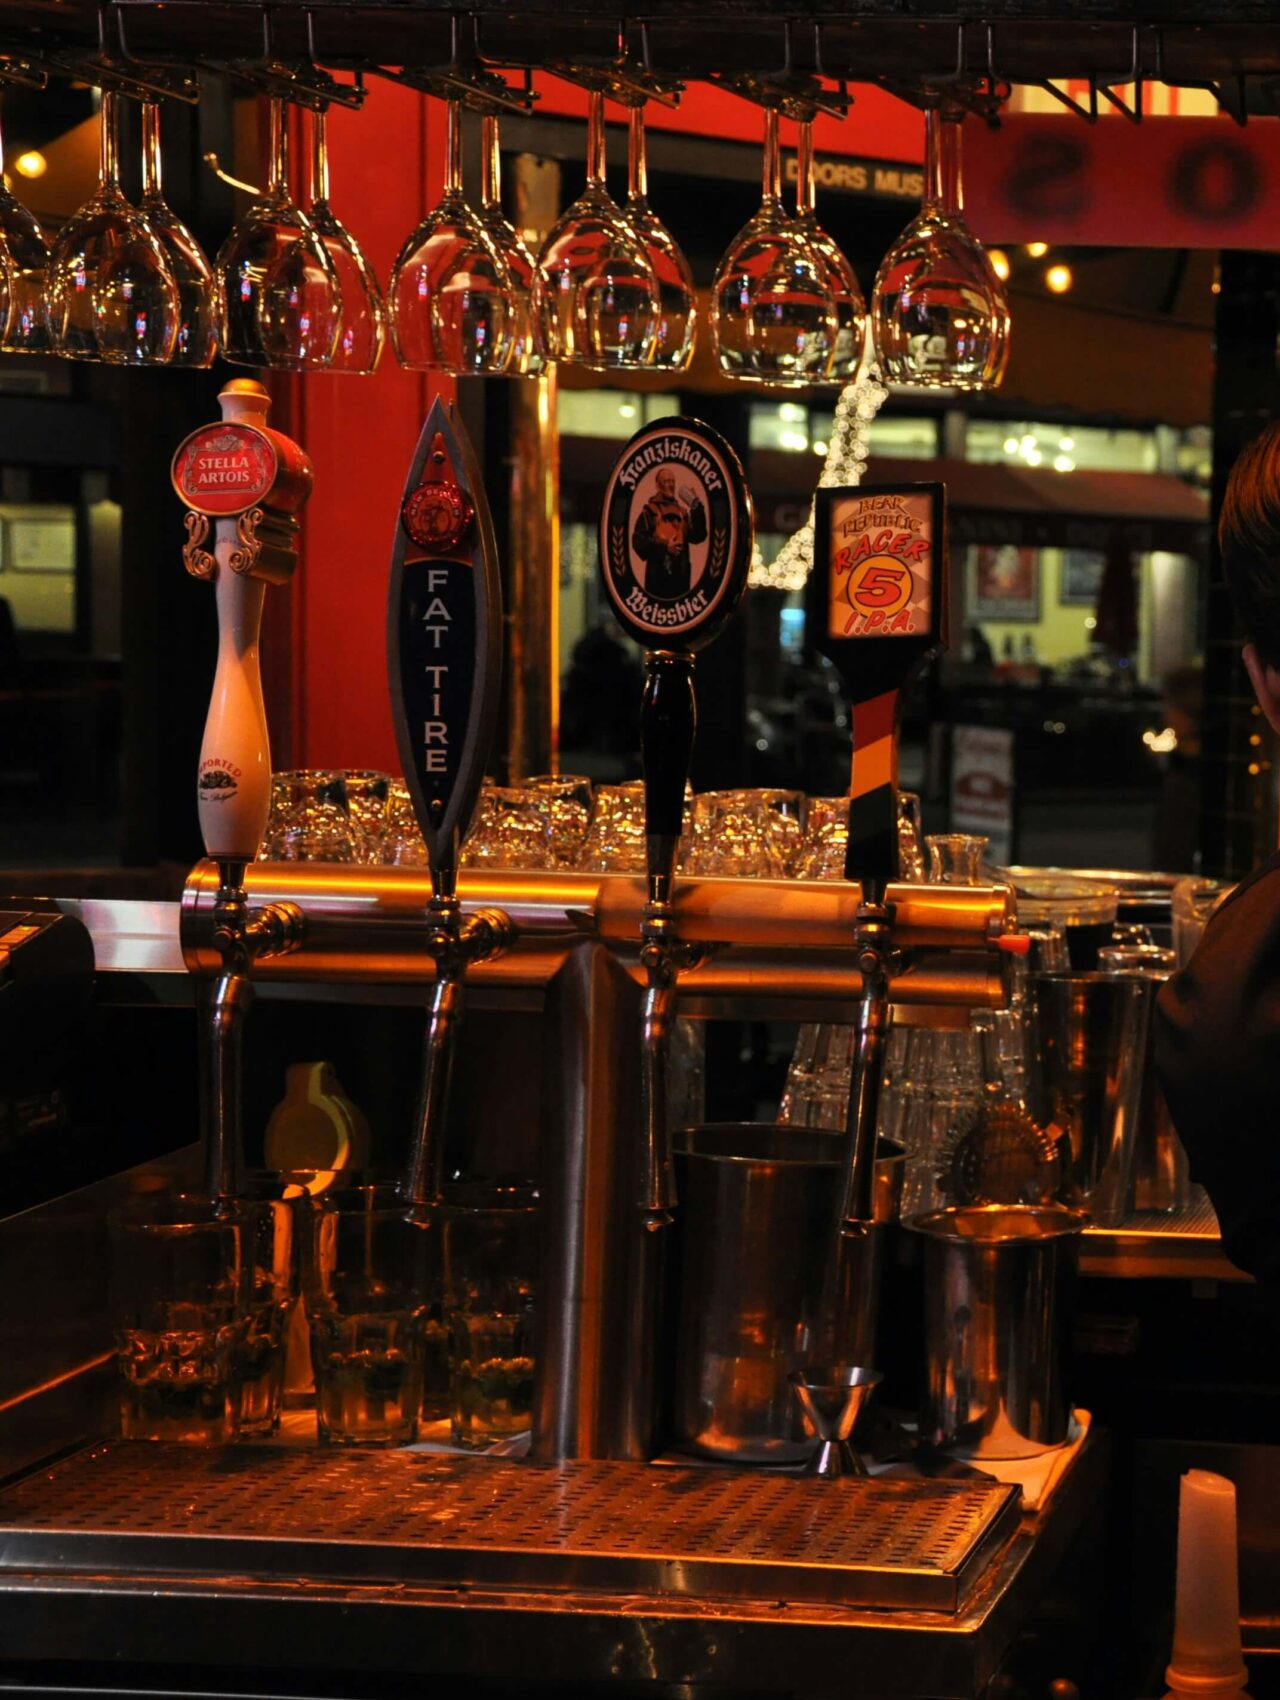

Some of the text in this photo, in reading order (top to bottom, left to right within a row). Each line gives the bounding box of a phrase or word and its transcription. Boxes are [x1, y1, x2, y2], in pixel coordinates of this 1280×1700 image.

[785, 157, 868, 191] DORS
[198, 456, 249, 470] STELLA
[198, 470, 250, 484] ARTOIS
[619, 437, 722, 491] Franziskaner
[859, 497, 907, 514] BEAR
[843, 514, 923, 538] REPUBLIC
[834, 529, 931, 575] RACER
[625, 586, 708, 625] Weissbier
[855, 567, 905, 608] 5
[422, 569, 453, 649] FAT
[843, 608, 914, 634] I.P.A.
[424, 665, 449, 773] TIRE
